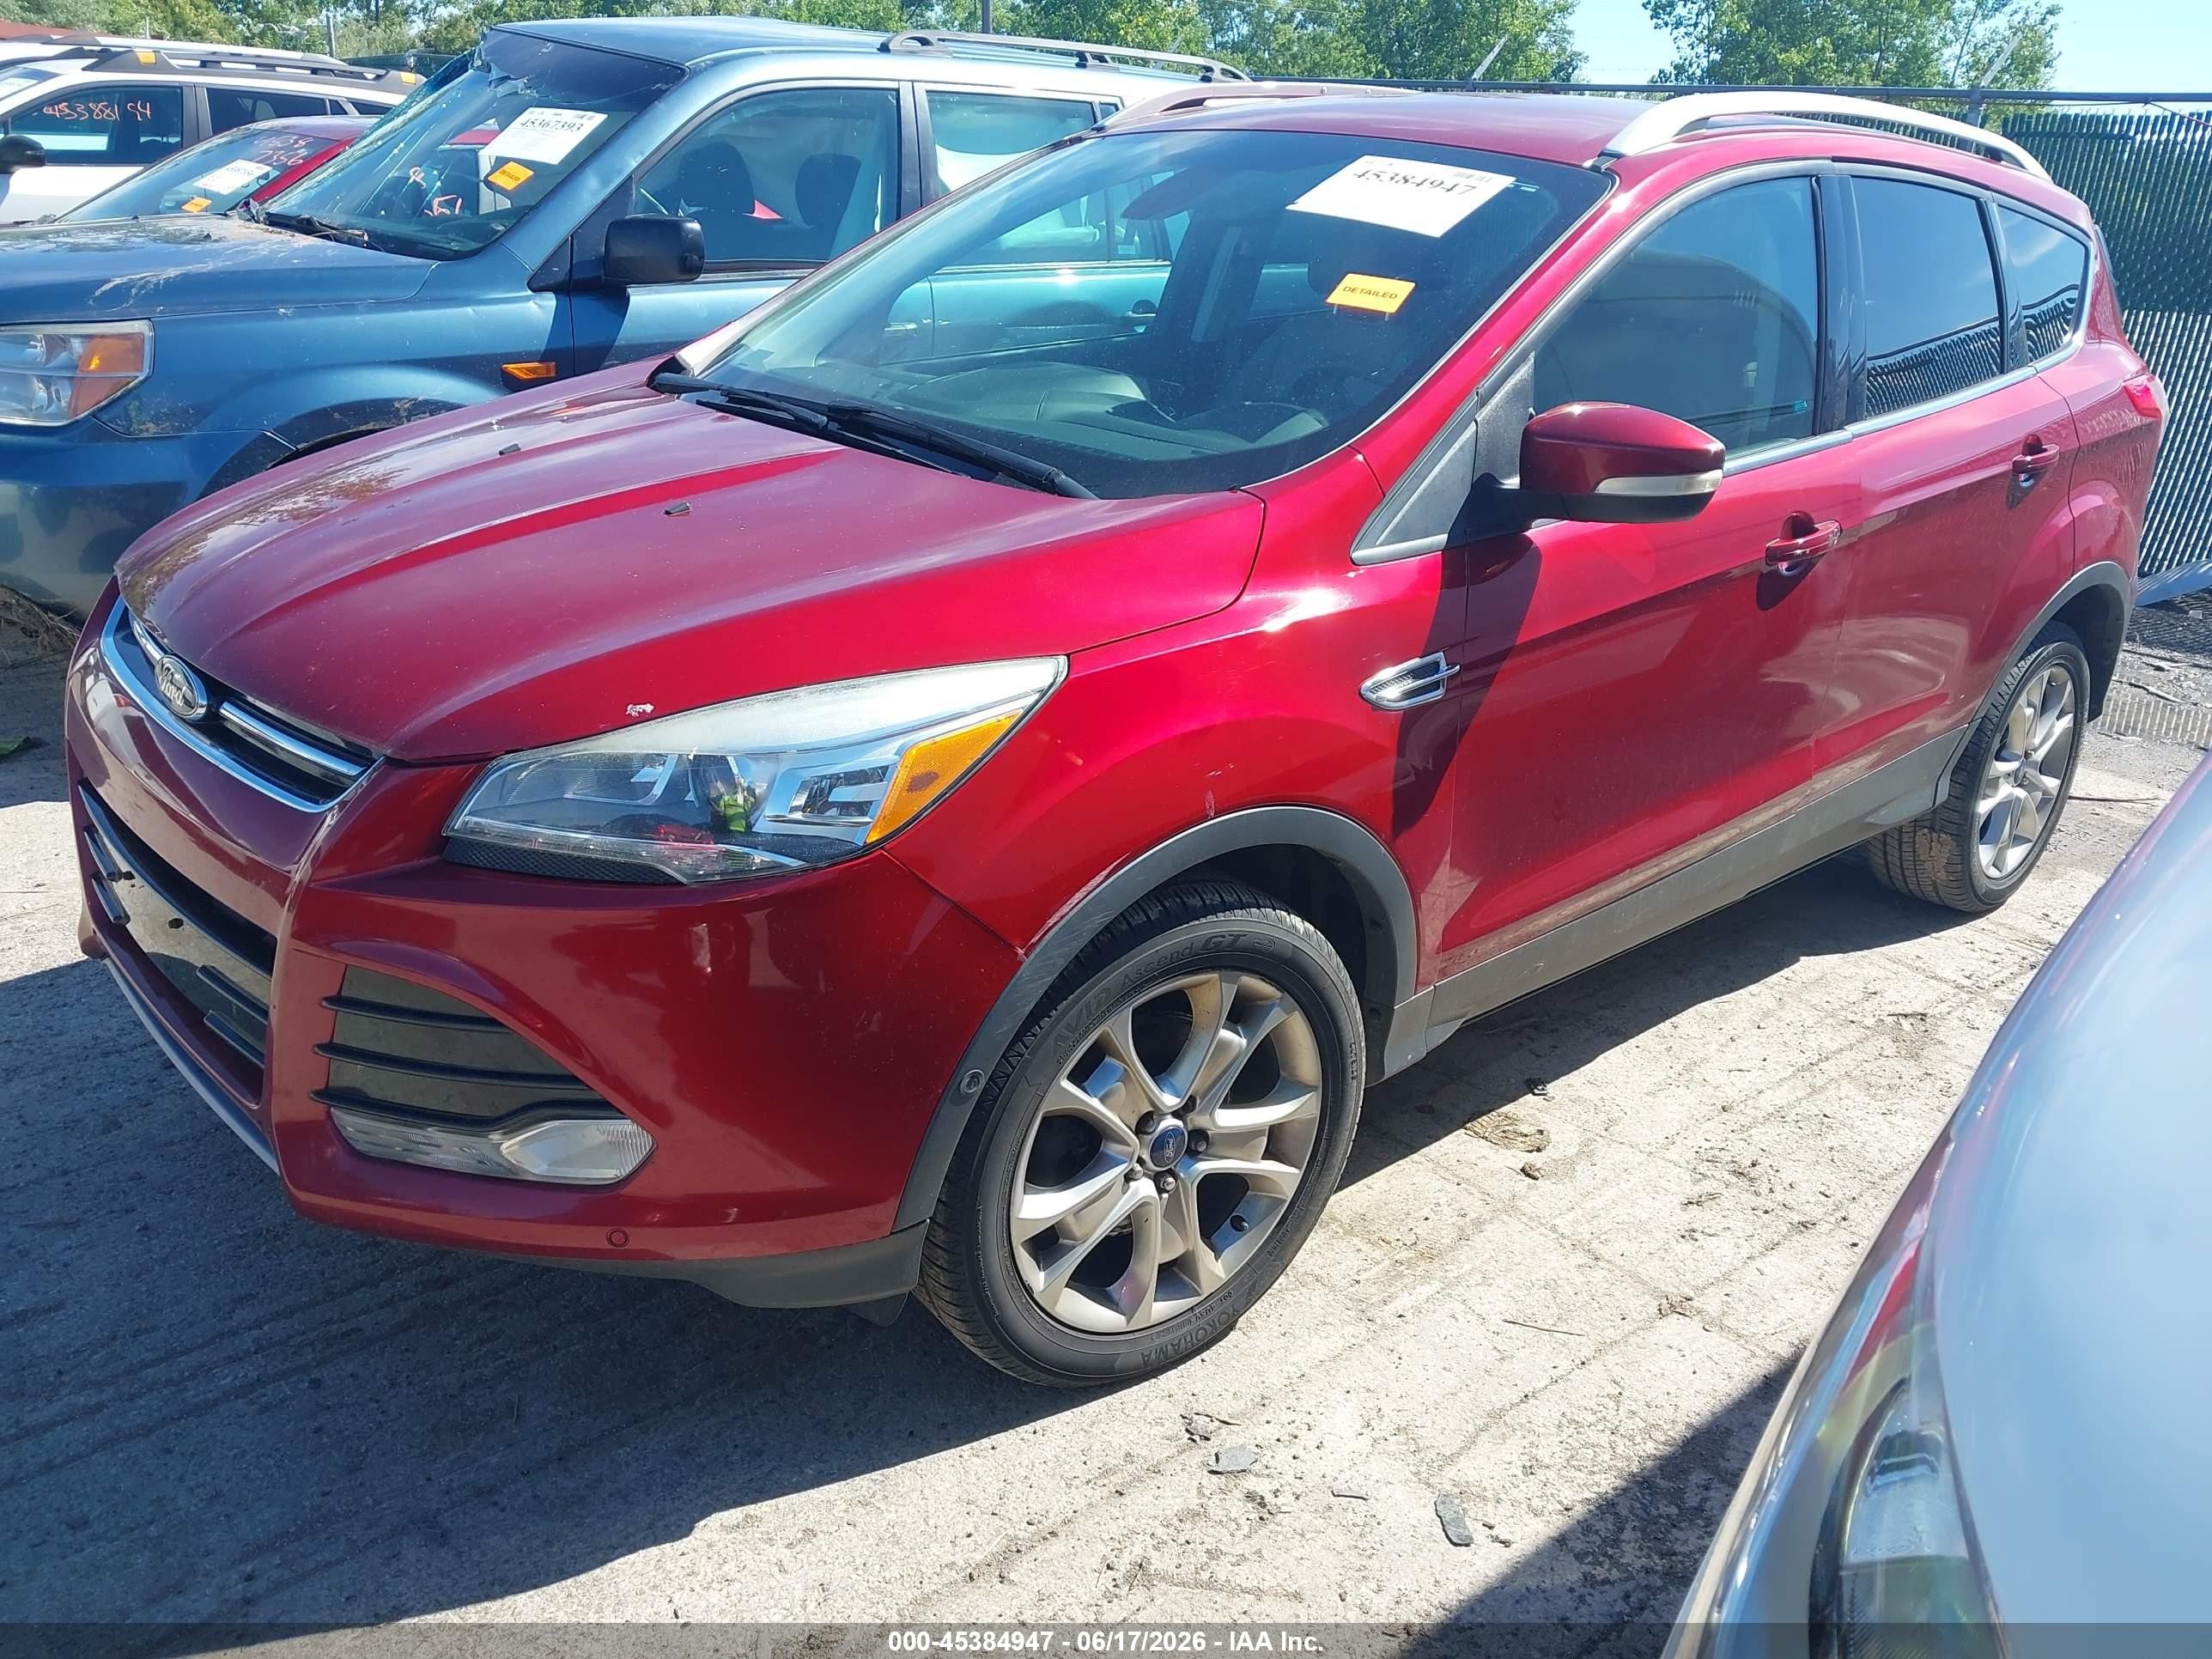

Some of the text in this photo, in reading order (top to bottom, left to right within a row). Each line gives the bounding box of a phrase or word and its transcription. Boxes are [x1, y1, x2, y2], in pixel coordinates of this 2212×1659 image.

[1352, 168, 1478, 196] 45384947
[1341, 285, 1399, 301] DETAILED
[159, 662, 186, 707] Ford
[1123, 943, 1194, 989] Ascend
[1200, 933, 1248, 953] GT
[1141, 1304, 1240, 1368] YOKOHAMA
